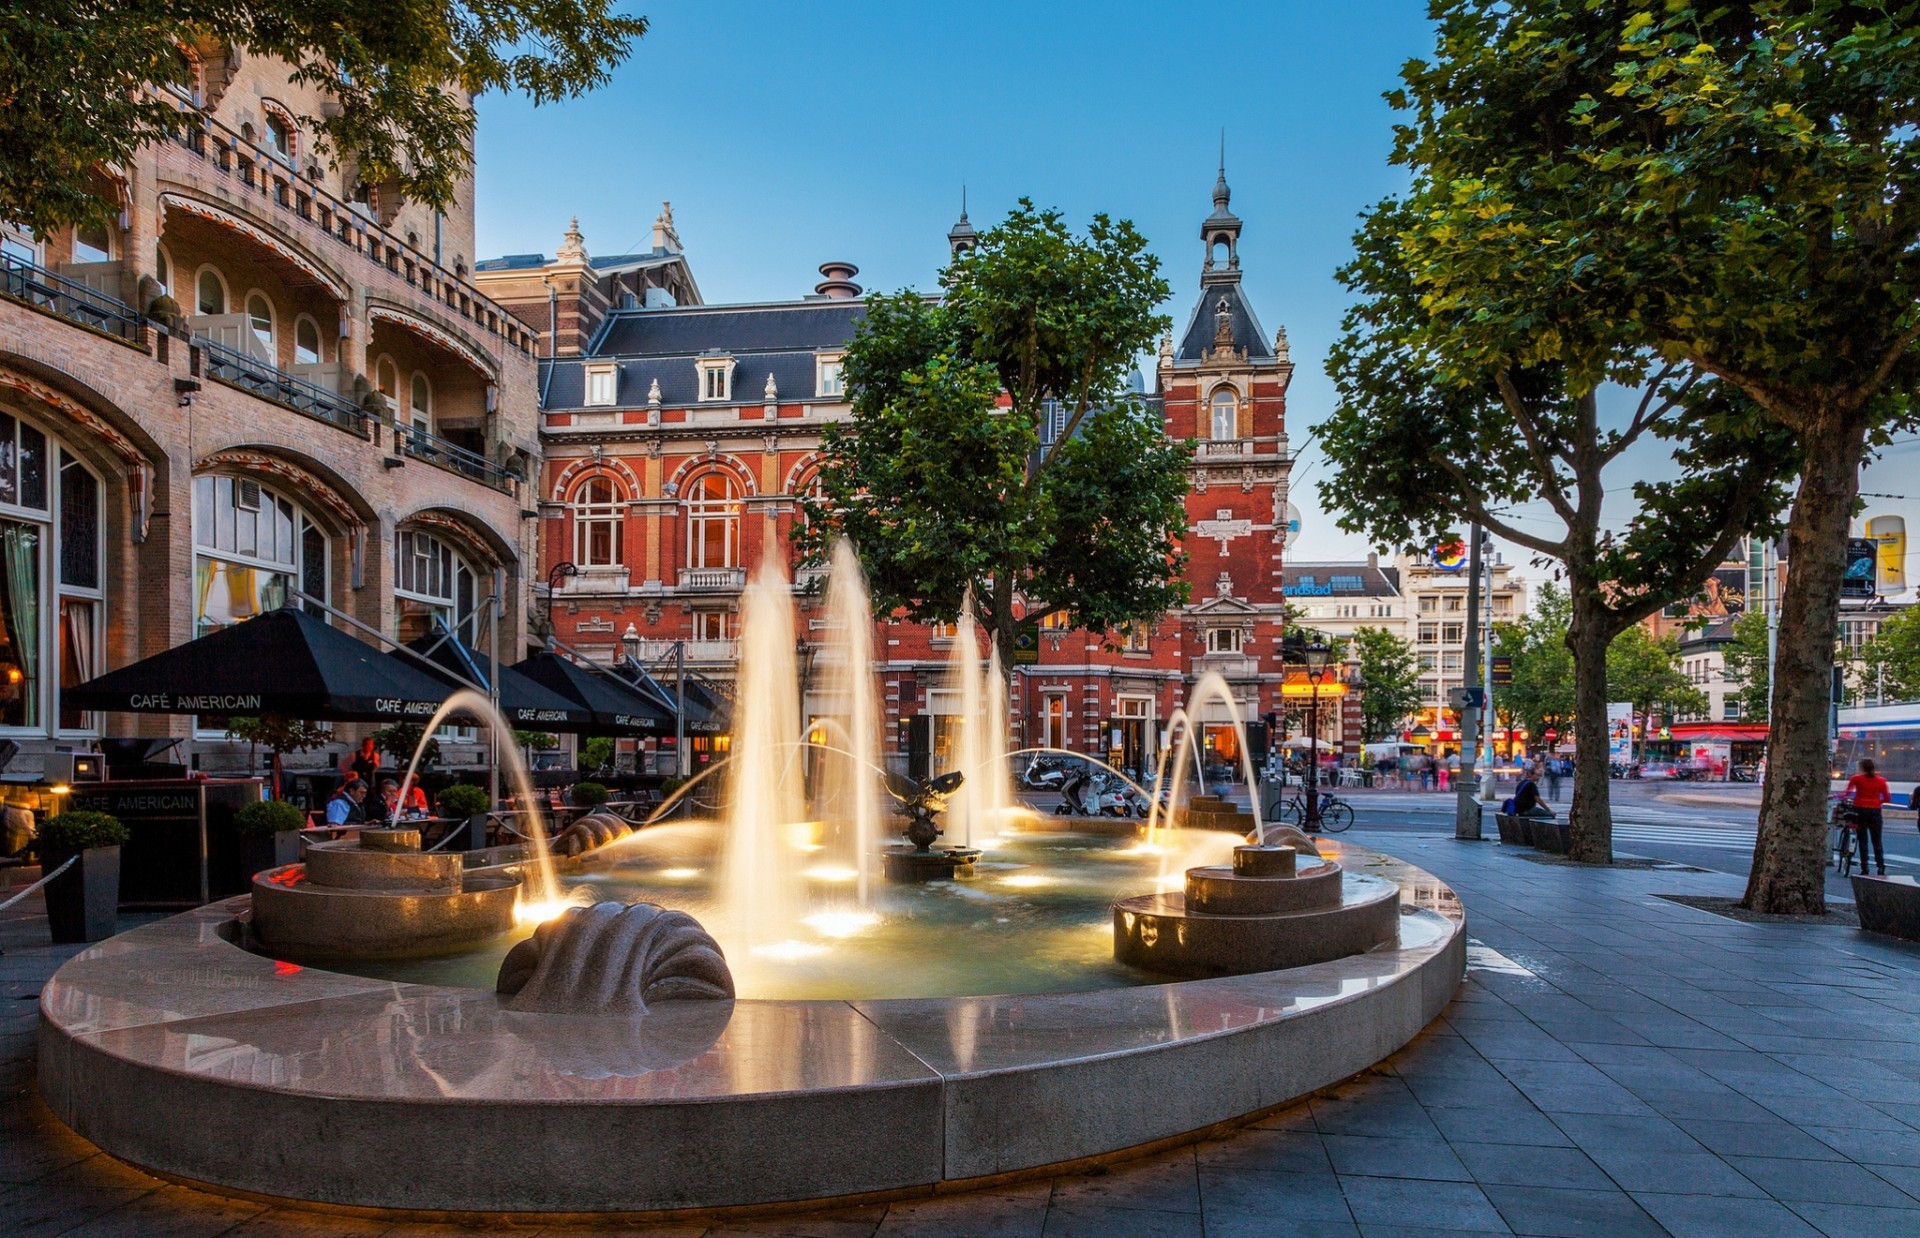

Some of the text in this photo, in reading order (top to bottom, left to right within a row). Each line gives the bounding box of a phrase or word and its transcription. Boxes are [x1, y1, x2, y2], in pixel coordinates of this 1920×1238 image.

[1282, 582, 1331, 596] andstad
[130, 692, 261, 709] CAFÉ AMERICAIN
[375, 698, 451, 715] CAFÉ AMERIC
[517, 708, 568, 721] CAFÉ AMERICAIN
[615, 714, 630, 726] CAFÉ
[117, 795, 194, 810] AMERICAIN
